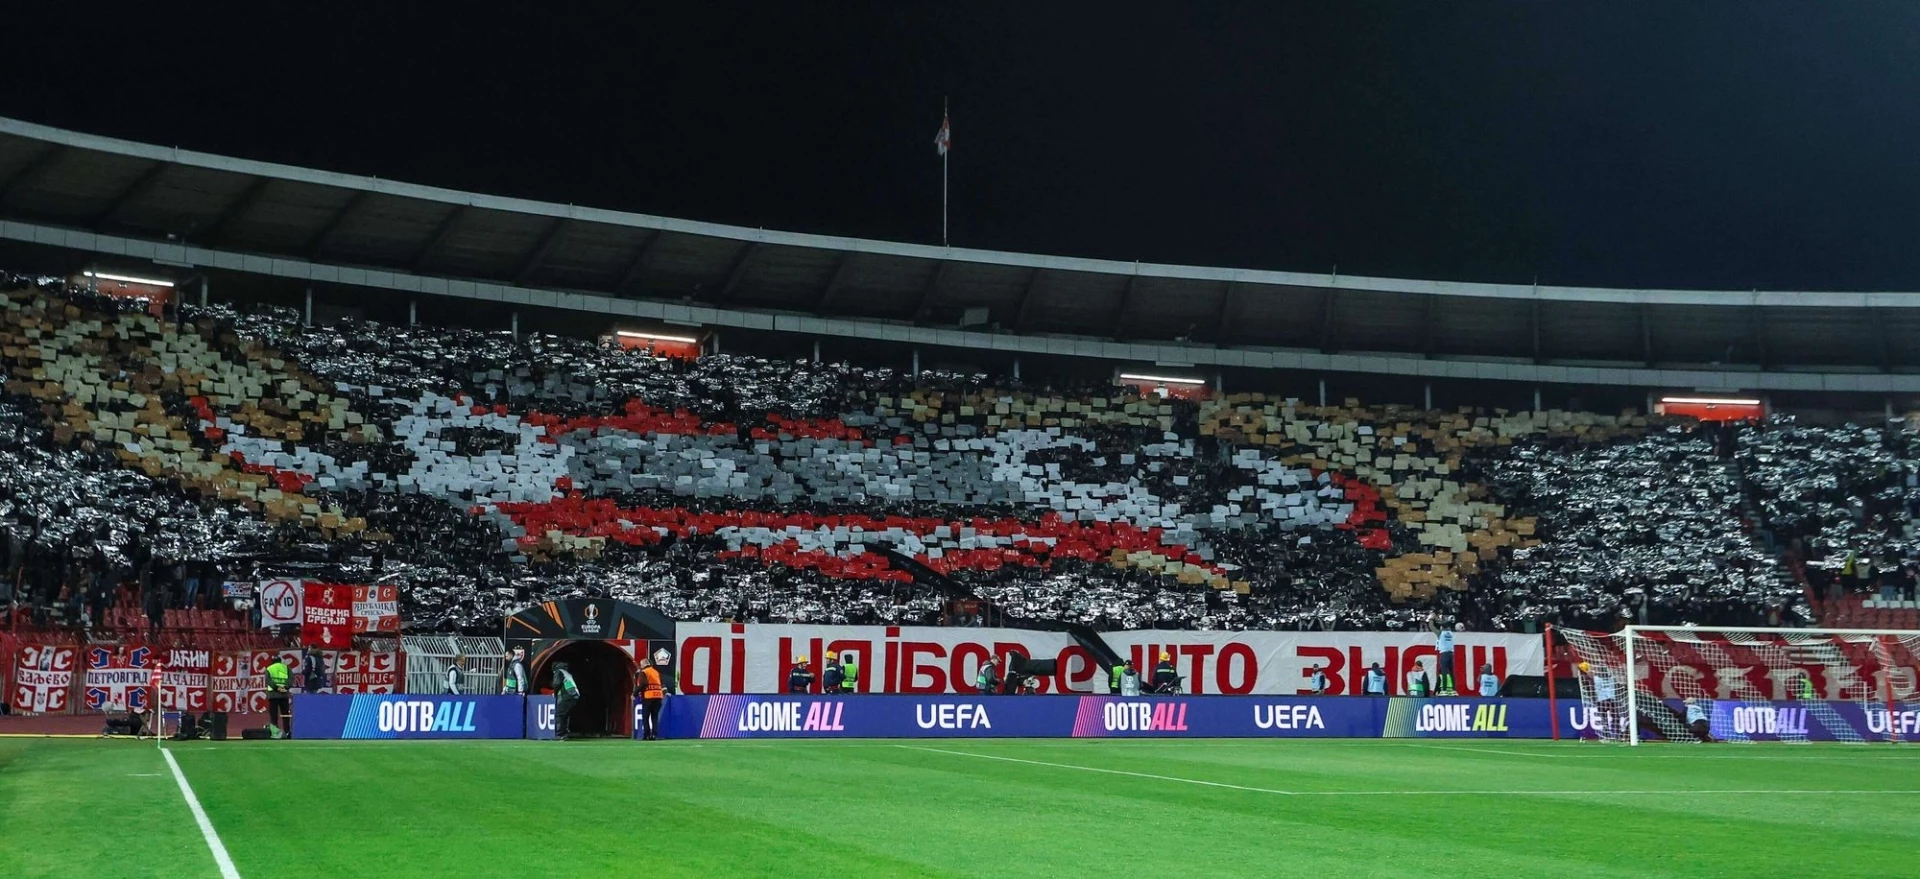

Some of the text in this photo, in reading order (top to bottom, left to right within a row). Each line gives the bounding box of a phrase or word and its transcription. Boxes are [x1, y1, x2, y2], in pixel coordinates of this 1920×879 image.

[264, 596, 294, 609] FAN ID
[305, 606, 350, 617] СЕВЕРНА
[307, 615, 346, 625] СРБИЈА
[87, 671, 148, 686] ПЕТРОВГРАД
[161, 672, 206, 686] АЧАНИ
[212, 676, 266, 691] КРАГУЈЕВА
[802, 702, 844, 731] ALL
[916, 704, 992, 729] UEFA
[1254, 704, 1325, 729] UEFA
[1471, 704, 1508, 732] ALL
